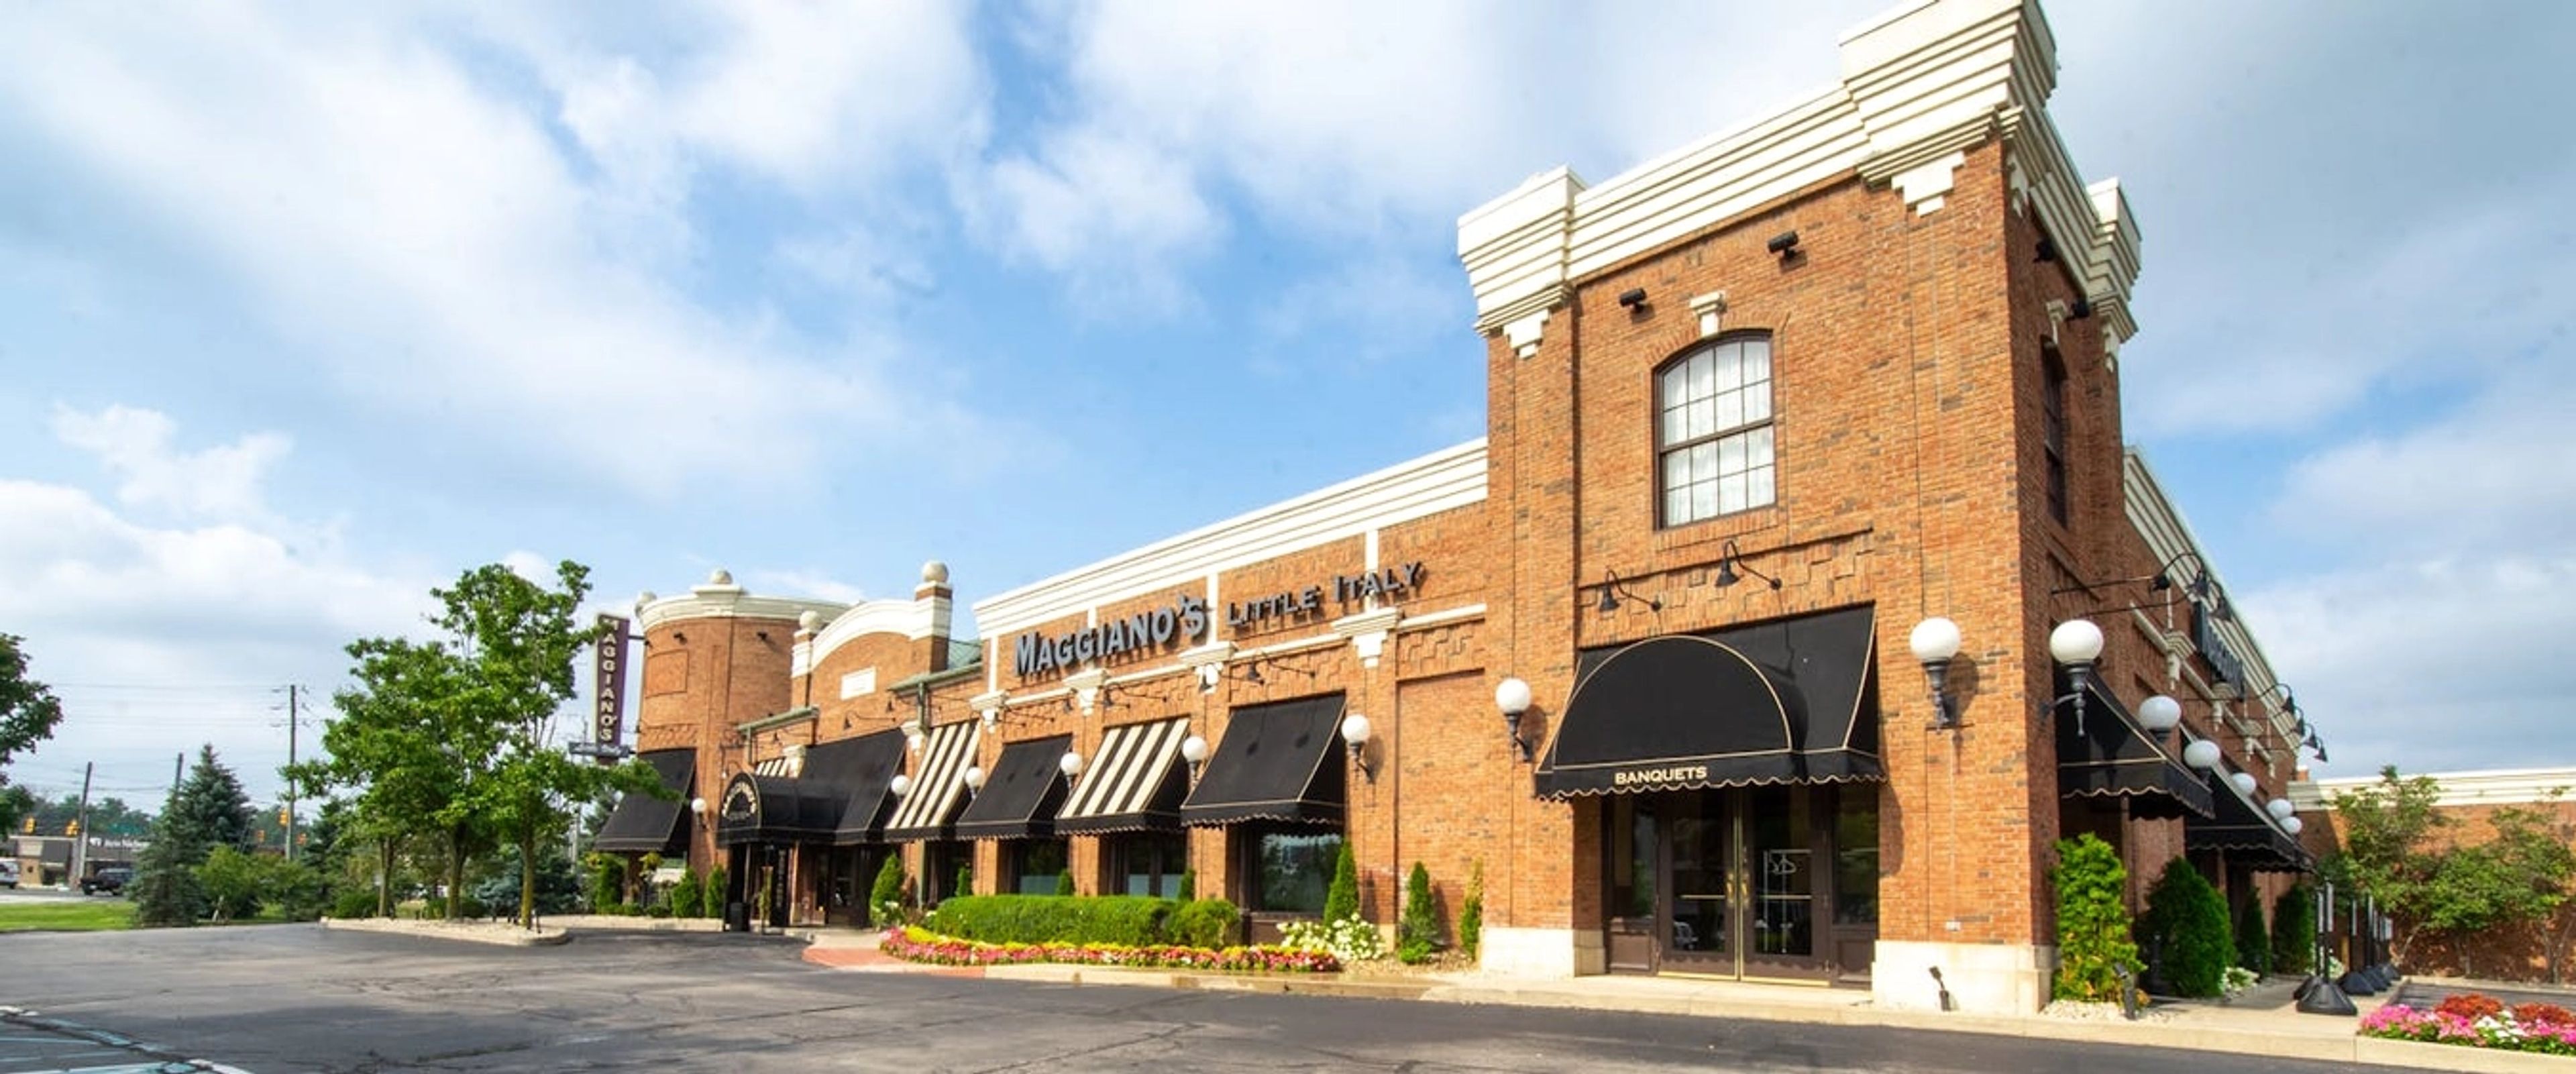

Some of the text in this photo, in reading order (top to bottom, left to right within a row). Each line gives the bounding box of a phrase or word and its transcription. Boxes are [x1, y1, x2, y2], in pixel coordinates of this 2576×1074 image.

[1016, 561, 1422, 676] MAGGIANO'S LITTLE ITALY
[1615, 765, 1707, 785] BANQUETS
